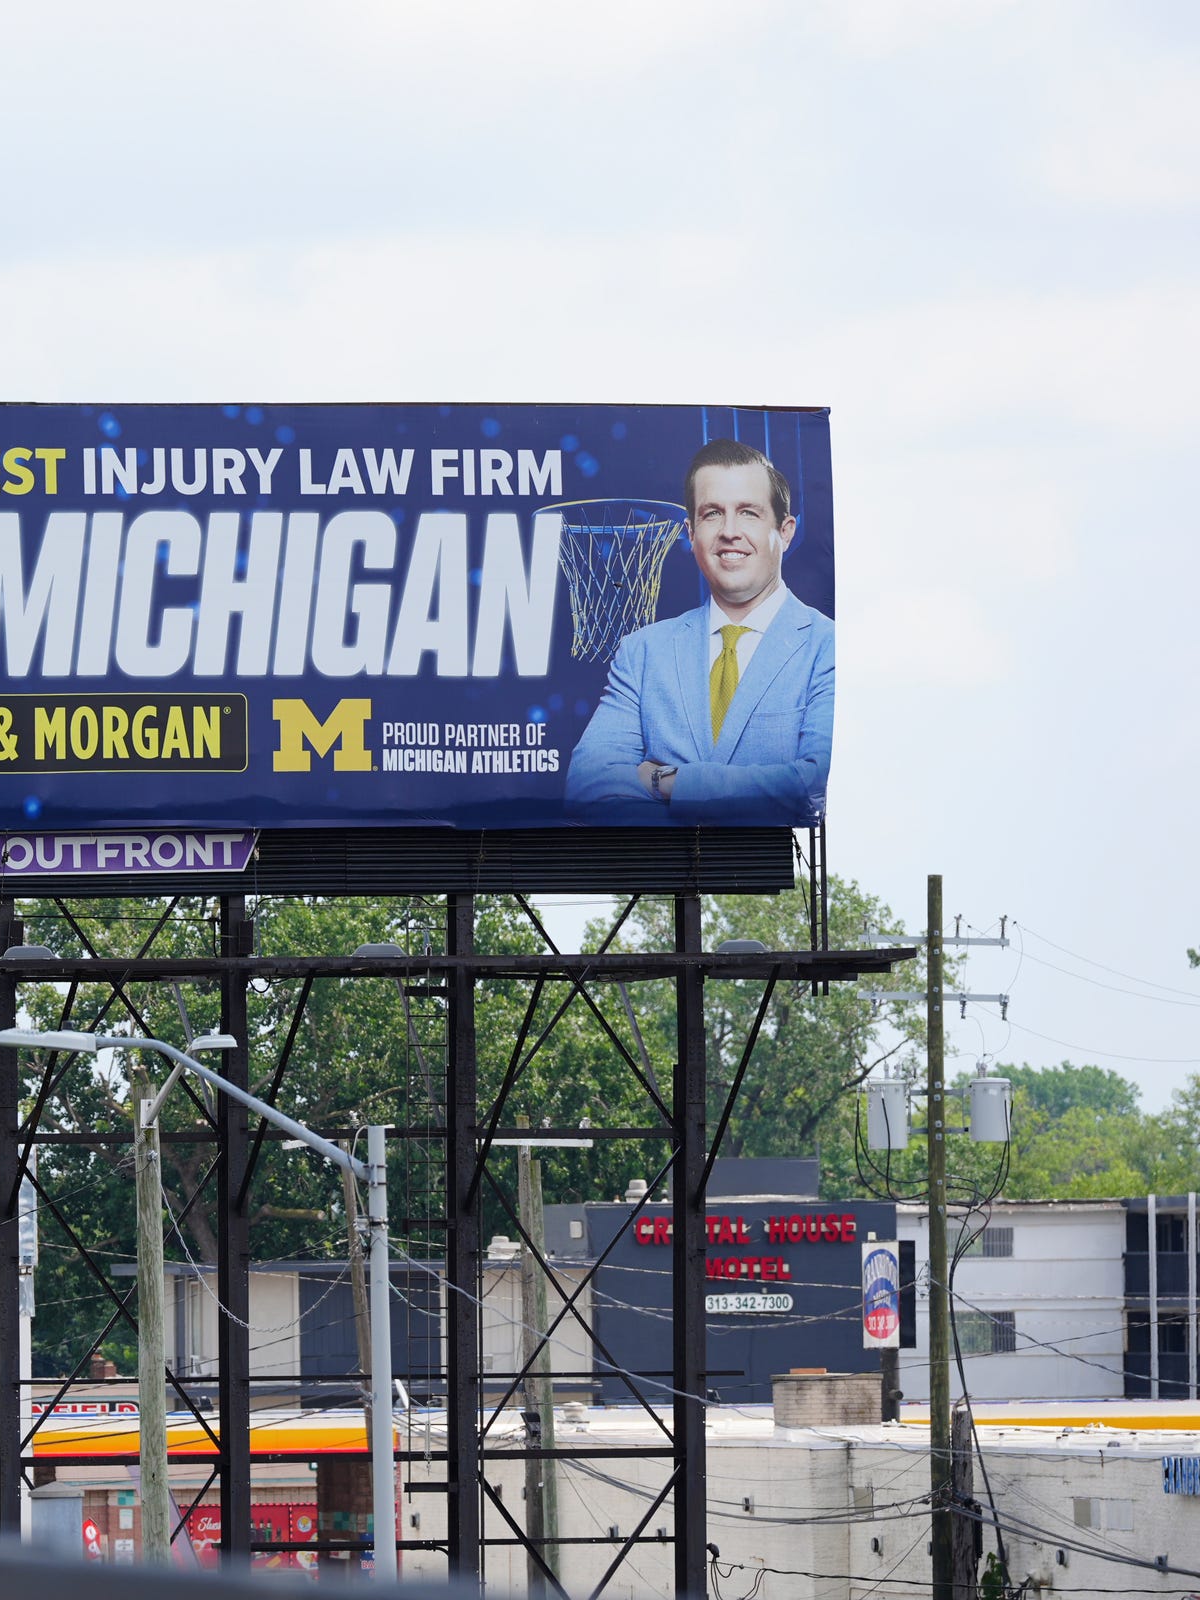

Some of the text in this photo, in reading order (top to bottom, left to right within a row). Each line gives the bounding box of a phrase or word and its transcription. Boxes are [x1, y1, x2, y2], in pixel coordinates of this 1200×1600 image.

[82, 447, 284, 496] INJURY
[298, 447, 414, 496] LAW
[430, 448, 563, 497] FIRM
[382, 722, 546, 747] PROUD PARTNER OF
[382, 749, 559, 774] MICHIGAN ATHLETICS
[1, 834, 246, 870] OUTFRONT
[635, 1213, 856, 1245] CRTAL HOUSE
[705, 1256, 792, 1280] MOTEL
[707, 1296, 790, 1310] 313-342-7300
